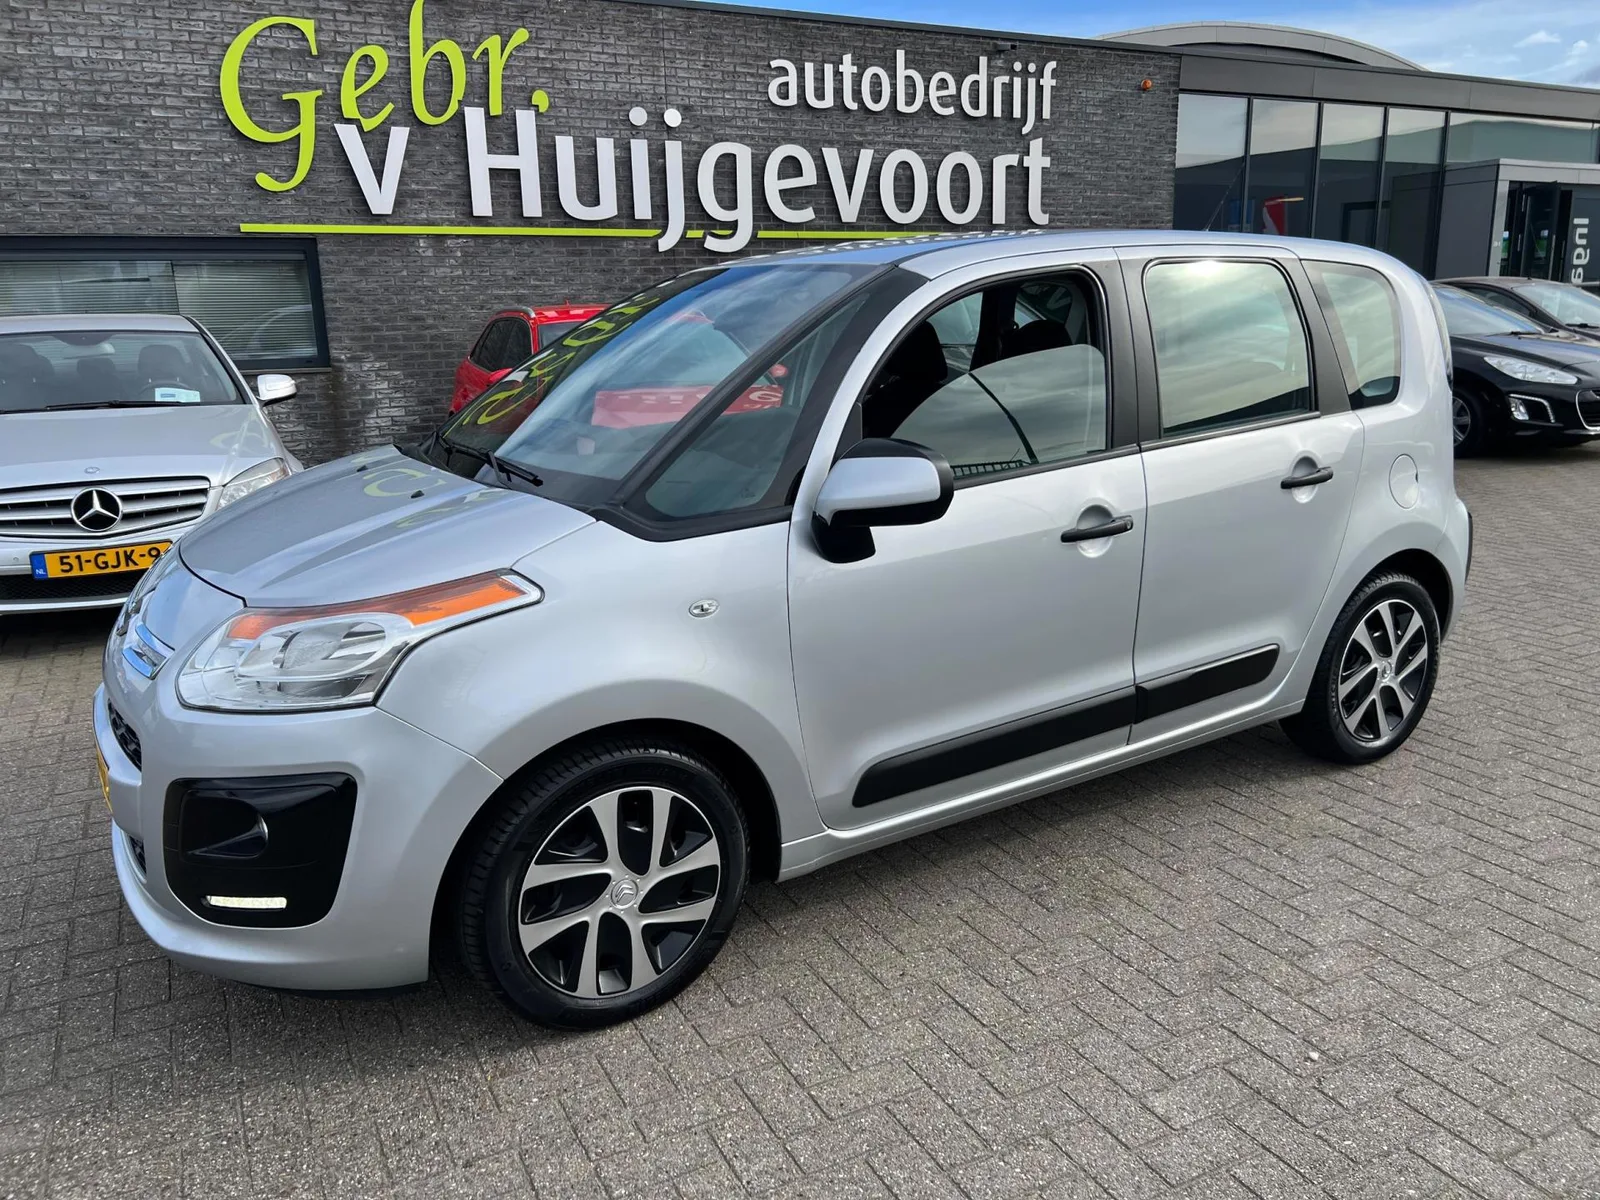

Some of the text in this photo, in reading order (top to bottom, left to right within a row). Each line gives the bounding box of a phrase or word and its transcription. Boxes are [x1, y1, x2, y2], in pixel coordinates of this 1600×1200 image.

[767, 49, 1058, 135] autobedrijf
[334, 106, 1051, 253] v Huijgevoort
[35, 546, 162, 576] NL 51-GJK-9
